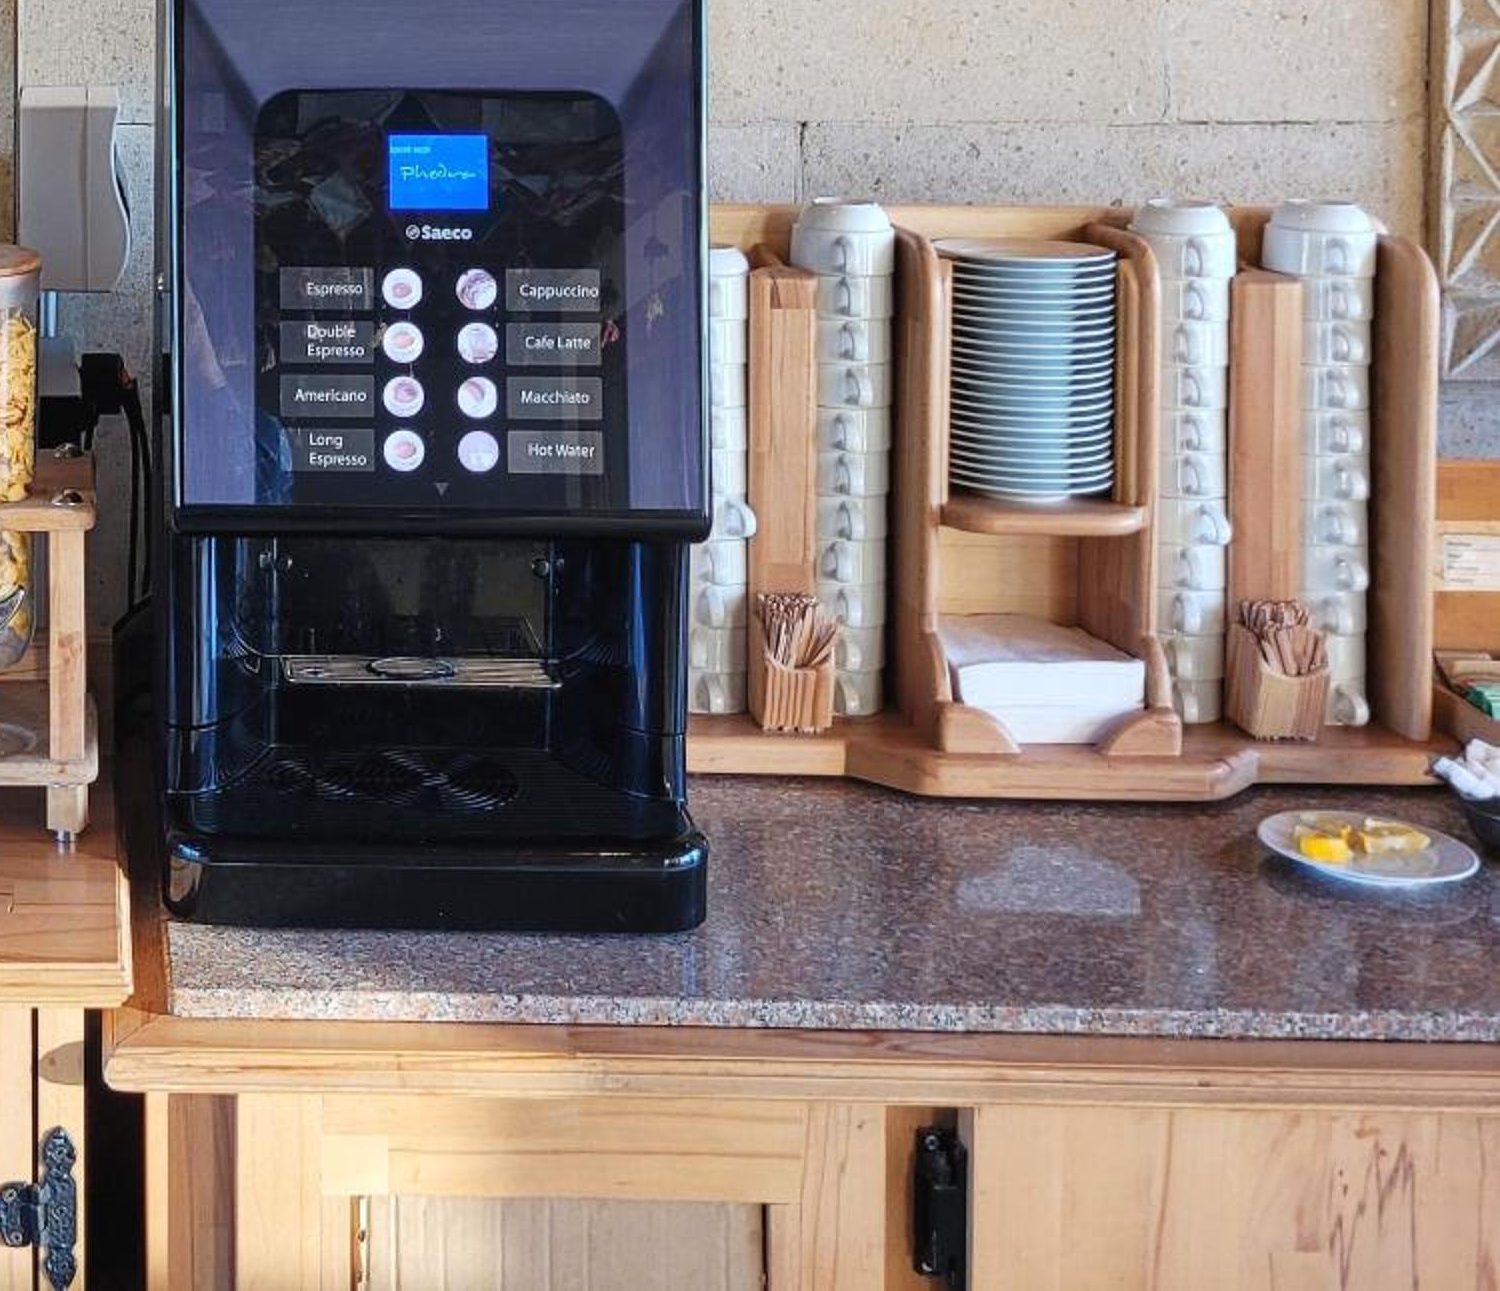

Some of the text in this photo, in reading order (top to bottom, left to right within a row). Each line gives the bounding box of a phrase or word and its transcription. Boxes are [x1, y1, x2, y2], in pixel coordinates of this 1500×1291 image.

[421, 224, 473, 240] Saeco
[306, 282, 363, 300] Espresso
[519, 284, 599, 302] Cappuccino
[307, 324, 356, 339] Double
[525, 336, 591, 350] Cafe Latte
[307, 343, 365, 360] Espresso
[294, 388, 367, 403] Americano
[521, 390, 590, 405] Macchiato
[309, 433, 343, 449] Long
[528, 443, 595, 458] Hot Water
[309, 452, 367, 468] Espresso
